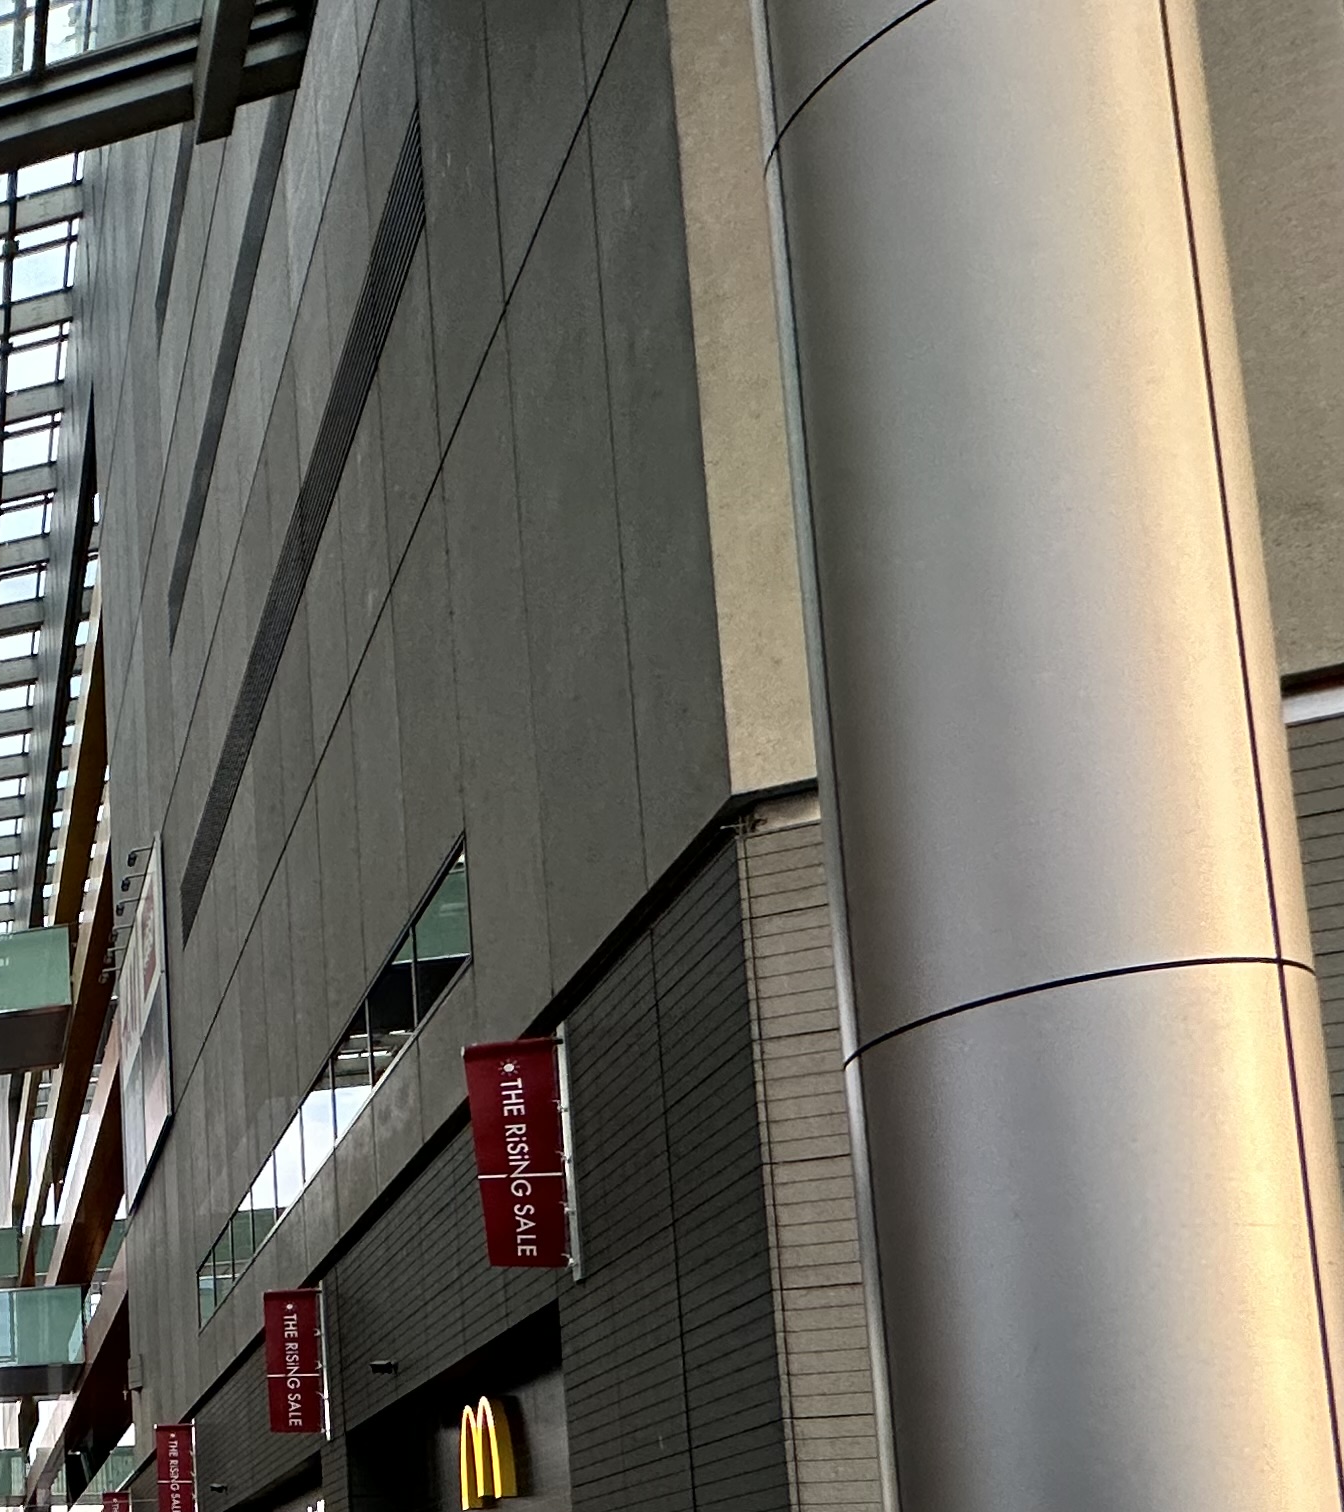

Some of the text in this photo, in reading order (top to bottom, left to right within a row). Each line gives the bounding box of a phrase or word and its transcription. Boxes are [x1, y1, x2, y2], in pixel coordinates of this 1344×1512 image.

[500, 1077, 526, 1116] THE
[513, 1203, 538, 1257] SALE
[283, 1313, 299, 1338] THE
[287, 1393, 303, 1427] SALE
